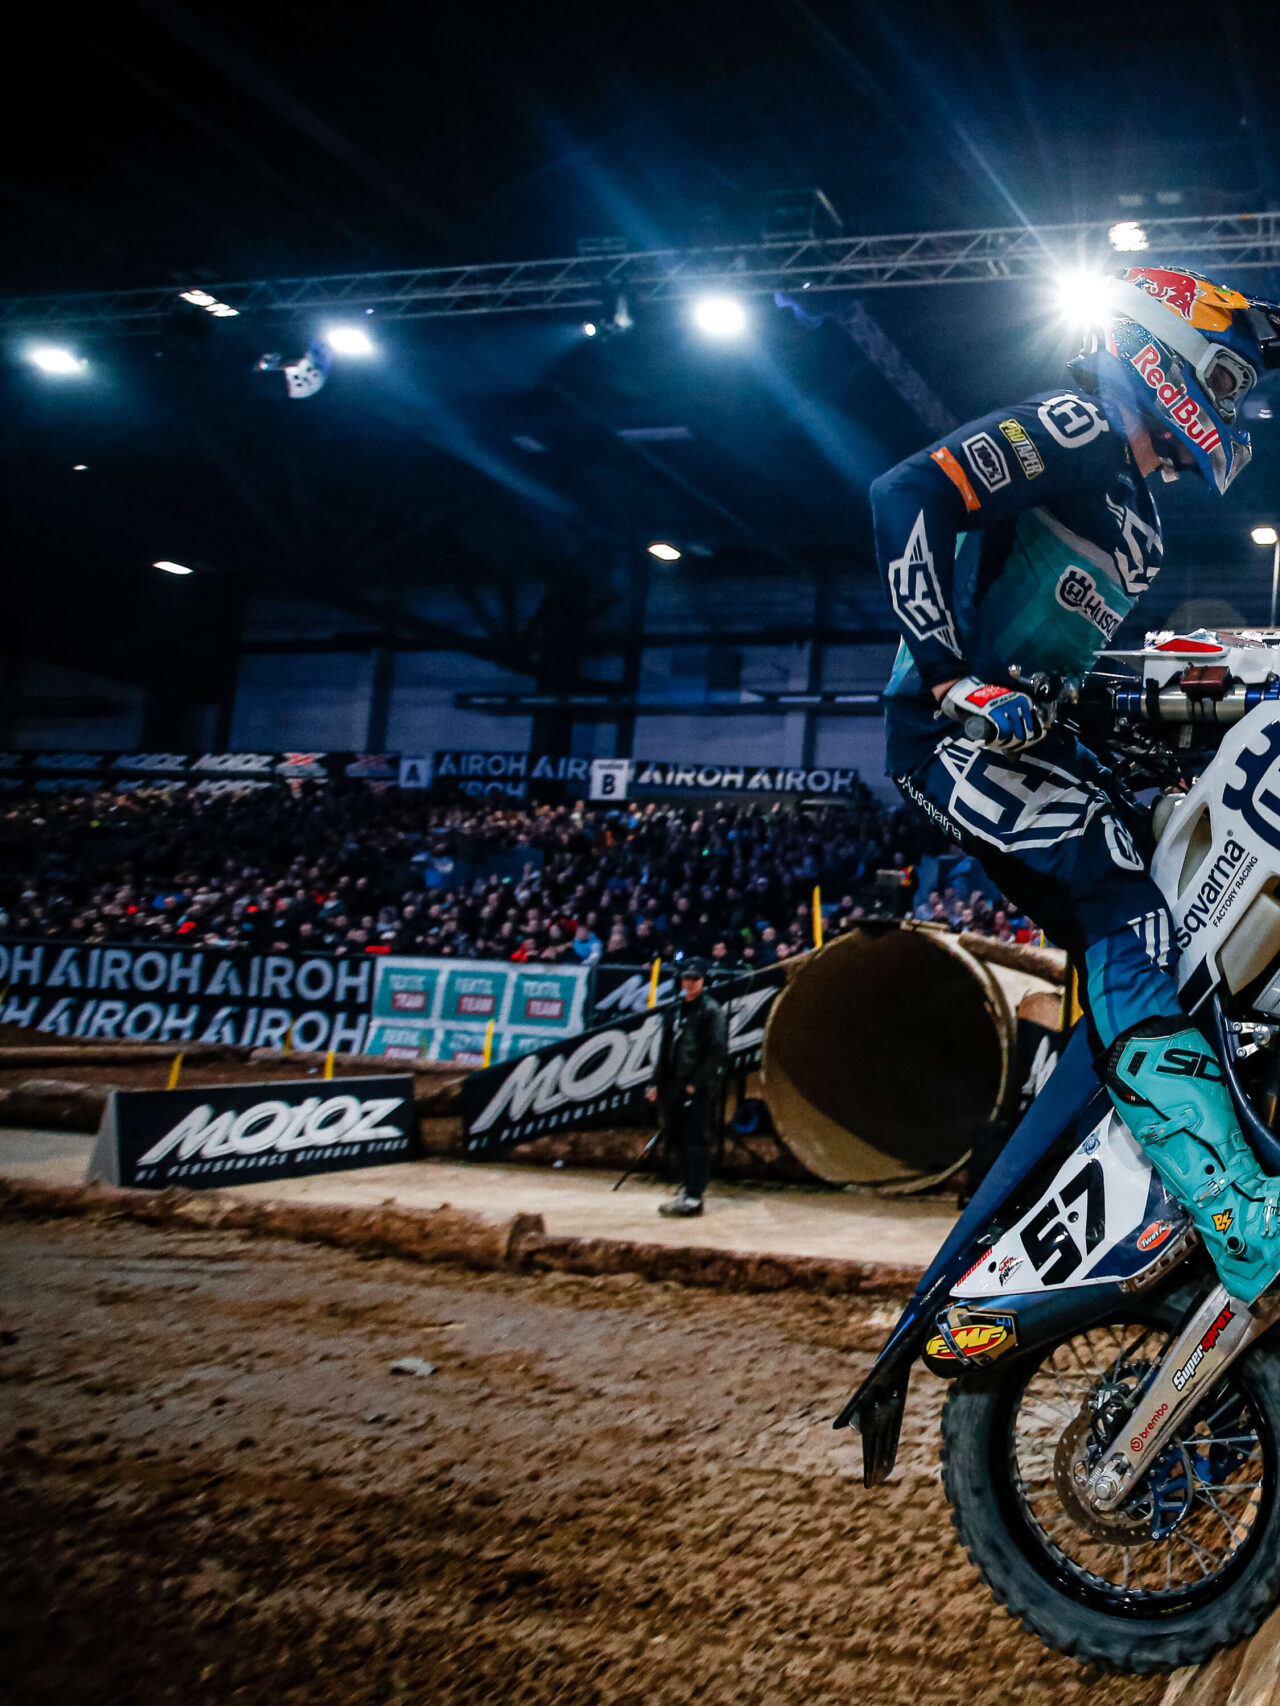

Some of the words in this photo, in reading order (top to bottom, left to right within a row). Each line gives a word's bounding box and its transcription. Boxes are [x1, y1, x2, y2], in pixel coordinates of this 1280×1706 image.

[1130, 343, 1187, 406] Red
[1171, 397, 1222, 454] Bull
[439, 752, 527, 776] AIROH
[602, 774, 615, 795] B
[637, 763, 744, 790] AIROH
[746, 769, 856, 795] AIROH
[1213, 886, 1243, 929] FACTORY
[1235, 855, 1259, 895] RACING
[46, 947, 204, 994] AIROH
[204, 954, 375, 1003] AIROH
[36, 997, 201, 1042] AIROH
[199, 1005, 371, 1056] AIROH
[469, 985, 782, 1135] MOTZ
[1019, 1157, 1106, 1287] 57
[926, 1325, 1005, 1356] FMF
[1140, 1403, 1169, 1439] brembo
